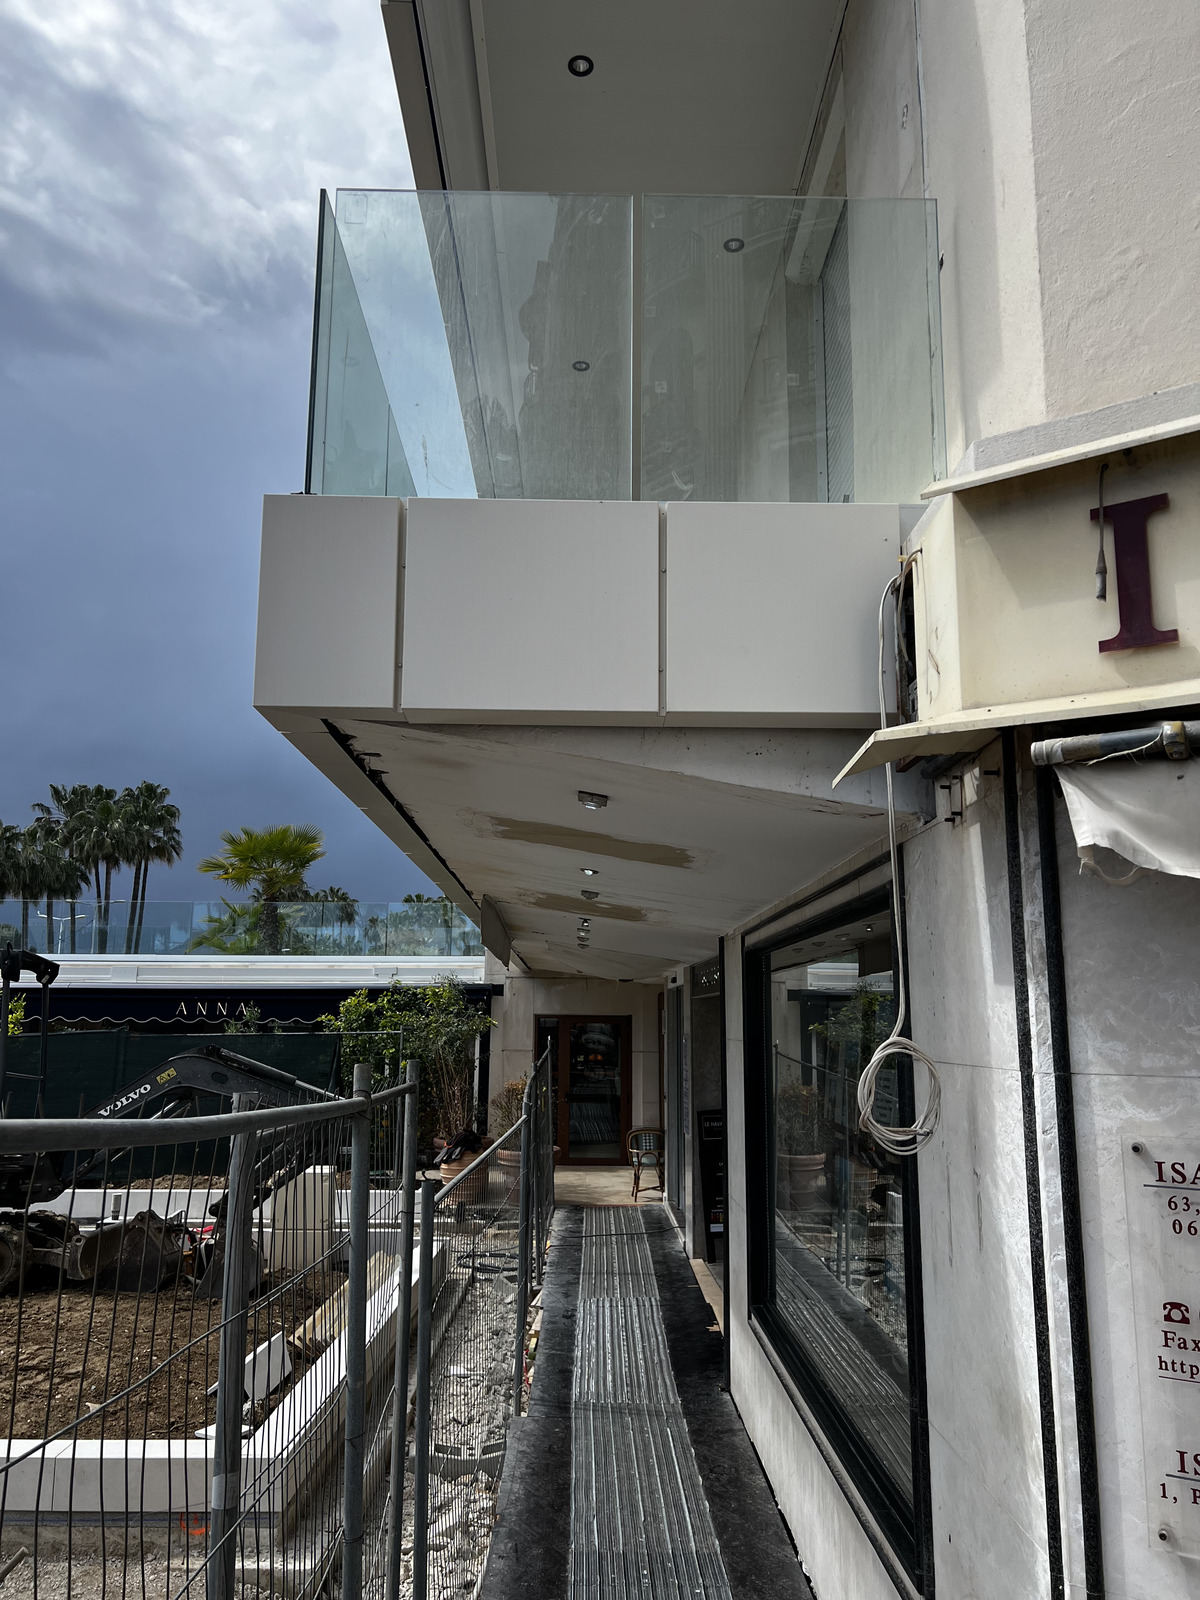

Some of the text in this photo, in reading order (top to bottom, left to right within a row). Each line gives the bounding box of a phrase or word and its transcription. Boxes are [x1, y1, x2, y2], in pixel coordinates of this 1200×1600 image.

[1090, 493, 1179, 653] I
[176, 1001, 247, 1016] ANNA
[97, 1083, 151, 1117] VOLVO
[1167, 1195, 1200, 1216] 63,
[1172, 1219, 1198, 1236] 06
[1161, 1329, 1200, 1352] Fax
[1157, 1355, 1200, 1379] http
[1159, 1482, 1178, 1504] 1,
